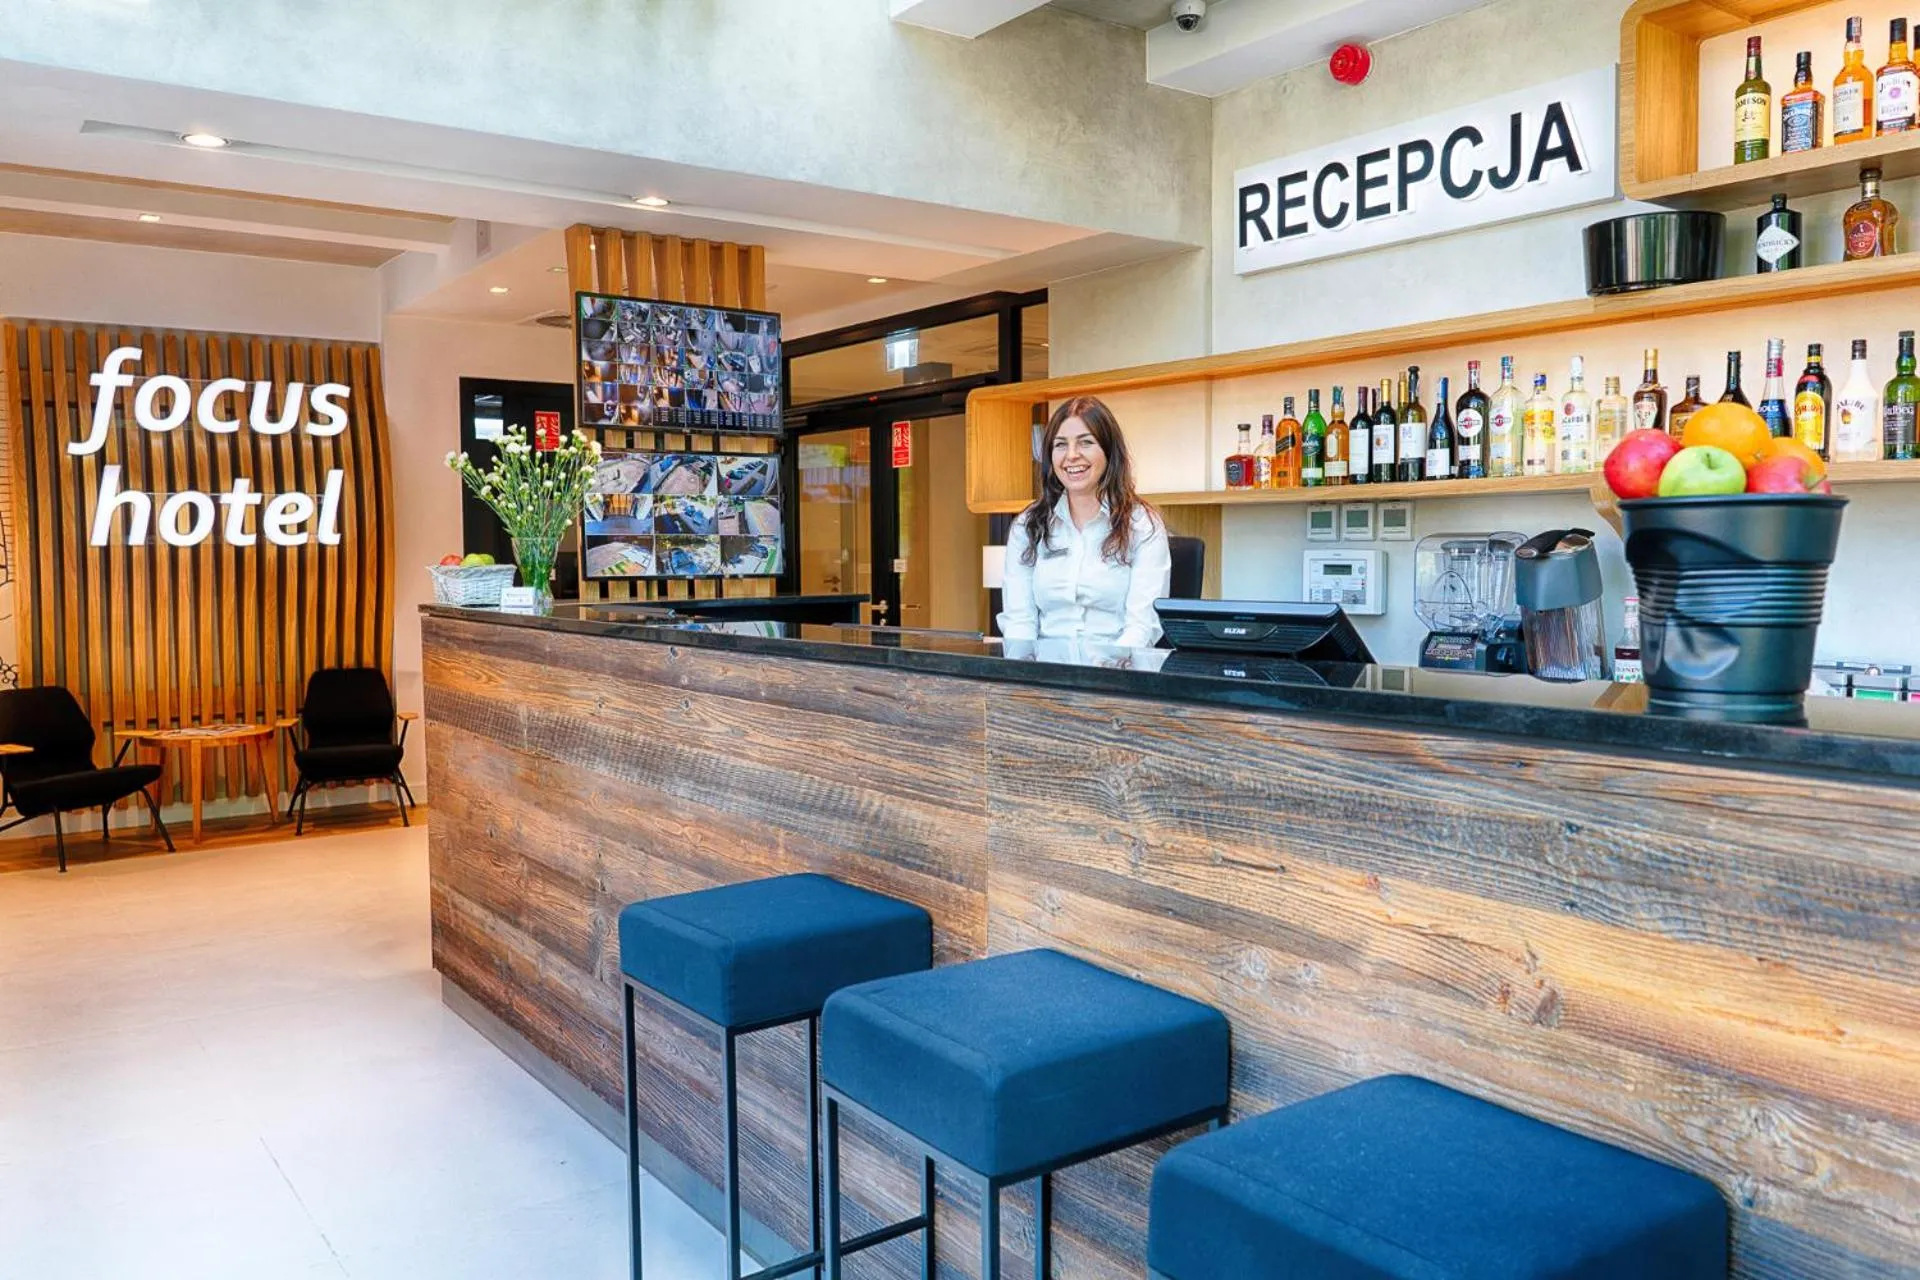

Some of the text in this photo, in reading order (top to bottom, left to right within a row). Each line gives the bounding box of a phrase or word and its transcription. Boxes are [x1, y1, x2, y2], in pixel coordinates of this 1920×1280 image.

[1238, 101, 1583, 249] RECEPCJA
[67, 346, 351, 456] focus
[90, 465, 344, 546] hotel
